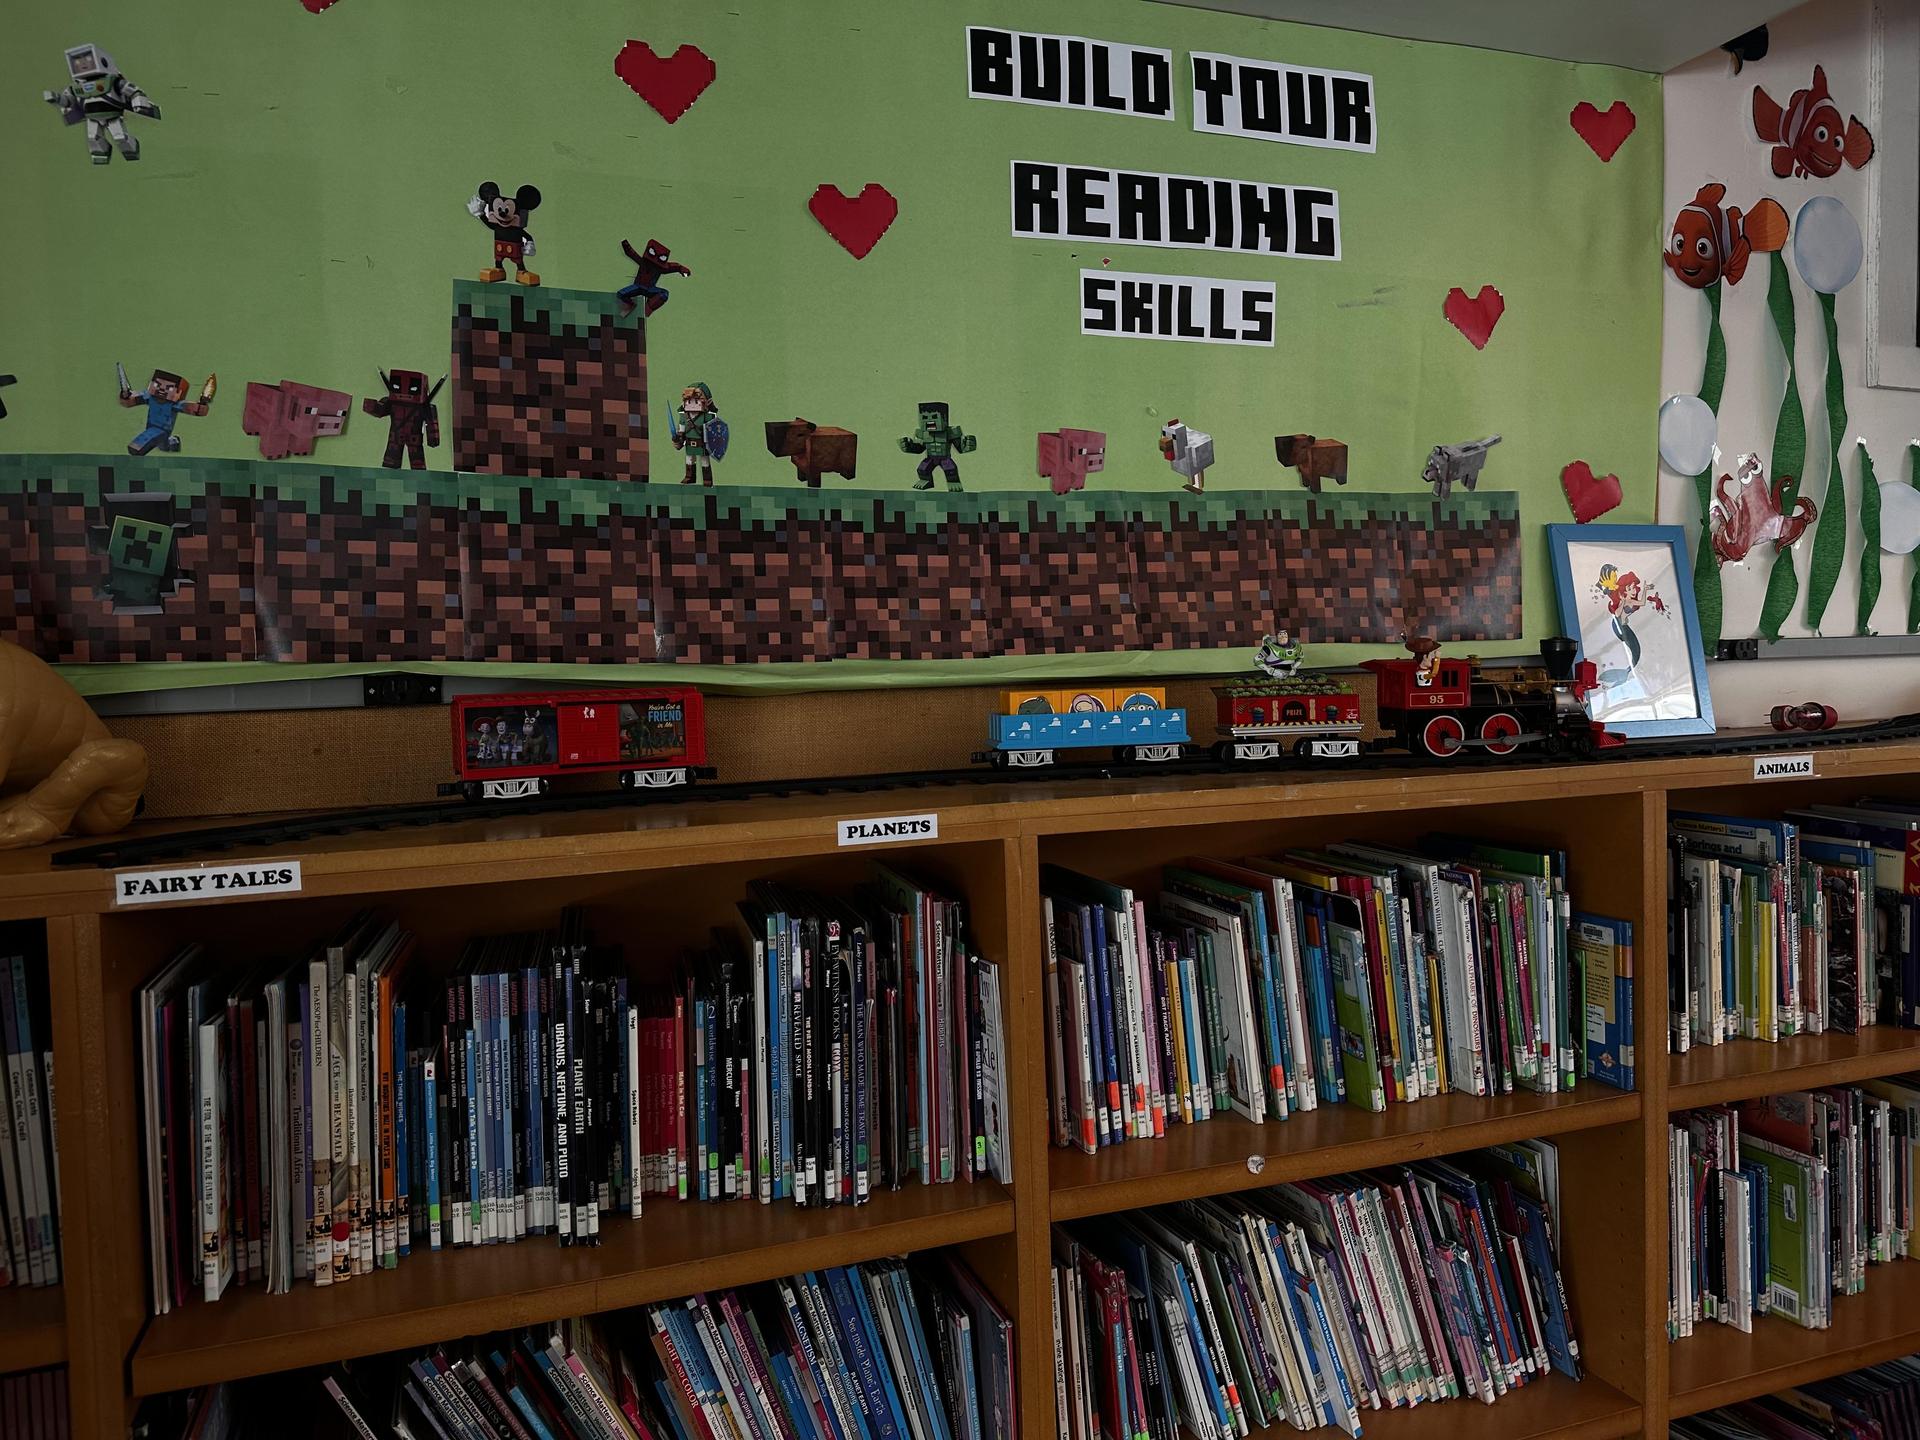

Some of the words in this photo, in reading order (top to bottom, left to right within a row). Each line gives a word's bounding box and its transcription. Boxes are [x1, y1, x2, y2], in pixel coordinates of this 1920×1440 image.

[970, 28, 1170, 116] BUILD
[1194, 57, 1371, 144] YOUR
[1014, 162, 1335, 256] READING
[1084, 278, 1273, 341] SKILLS
[648, 709, 683, 722] FRIEND
[1286, 708, 1303, 716] PRIZE
[1429, 695, 1444, 704] 95
[1757, 762, 1810, 775] ANIMALS
[847, 820, 931, 838] PLANETS
[124, 875, 205, 896] FAIRY
[212, 869, 293, 889] TALES
[1430, 870, 1440, 905] MOUNTAIN
[1386, 900, 1396, 926] PLANT
[1433, 906, 1442, 935] WILDLIFE
[1389, 928, 1398, 944] LIFE
[1463, 919, 1472, 943] Barlowe
[830, 944, 840, 1002] EYEWITNESS
[1466, 952, 1473, 962] AN
[312, 984, 320, 997] The
[1466, 964, 1477, 997] ALPHABET
[313, 997, 321, 1019] AESOP
[831, 1006, 841, 1039] BOOKS
[1114, 986, 1123, 1029] STEGOSAURUS
[1161, 1012, 1169, 1031] TRACK
[313, 1020, 321, 1028] for
[793, 1004, 801, 1049] REVEALED
[937, 1018, 945, 1047] Habitats
[1470, 1010, 1481, 1049] DINOSAURS
[314, 1029, 322, 1066] CHILDREN
[554, 1023, 565, 1068] URANUS,
[707, 1023, 716, 1061] worldwise
[770, 1045, 779, 1065] cycles
[1132, 1034, 1141, 1074] PLESIOSAURUS
[1163, 1032, 1171, 1056] RACING
[332, 1054, 340, 1078] JACK
[573, 1058, 583, 1097] PLANET
[708, 1066, 716, 1087] space
[725, 1057, 733, 1089] MERCURY
[771, 1066, 780, 1080] Life
[794, 1054, 802, 1077] SPACE
[25, 1068, 35, 1096] Common
[555, 1071, 567, 1120] NEPTUNE,
[629, 1089, 637, 1105] Space
[11, 1071, 21, 1098] Cowries,
[17, 1121, 26, 1141] Credit
[28, 1098, 36, 1115] Cents
[203, 1109, 211, 1121] FOOL
[574, 1100, 584, 1134] EARTH
[292, 1105, 302, 1154] Traditional
[333, 1103, 342, 1157] BEANSTALK
[556, 1123, 567, 1145] AND
[204, 1146, 212, 1162] WORLD
[293, 1155, 302, 1183] Africa
[557, 1148, 568, 1177] PLUTO
[205, 1182, 213, 1200] FLYING
[205, 1203, 213, 1215] SHIP
[1356, 1215, 1363, 1224] ON
[1362, 1237, 1371, 1252] MOVE
[1361, 1213, 1373, 1238] HABITATS
[1552, 1270, 1569, 1311] SPOTLIGHT
[801, 1287, 814, 1310] Science
[810, 1310, 824, 1338] Matters!
[811, 1286, 825, 1310] Science
[819, 1309, 834, 1337] Matters!
[701, 1306, 716, 1329] Science
[710, 1329, 728, 1357] Matters!
[790, 1311, 819, 1365] MAGNETISM
[661, 1333, 680, 1363] LIGHT
[673, 1362, 685, 1378] AND
[680, 1377, 700, 1409] COLOR
[846, 1316, 859, 1333] See
[859, 1358, 877, 1388] Planet
[869, 1388, 886, 1415] Earth
[1152, 1367, 1160, 1384] DANES
[1220, 1350, 1232, 1382] STEGOSAURUS
[424, 1377, 444, 1401] Science
[440, 1399, 461, 1426] Matters!
[435, 1375, 453, 1399] Science
[451, 1397, 472, 1424] Matters!
[466, 1379, 501, 1425] EYEWITNESS
[548, 1368, 568, 1392] Science
[563, 1390, 585, 1418] Matters!
[579, 1373, 598, 1399] Science
[594, 1396, 615, 1425] Matters!
[830, 1372, 848, 1403] Changing
[842, 1403, 858, 1433] materials
[840, 1371, 859, 1405] Dissolving
[849, 1371, 862, 1394] PLANET
[857, 1394, 869, 1415] EARTH
[337, 1395, 359, 1419] Science
[736, 1390, 754, 1419] Keeping
